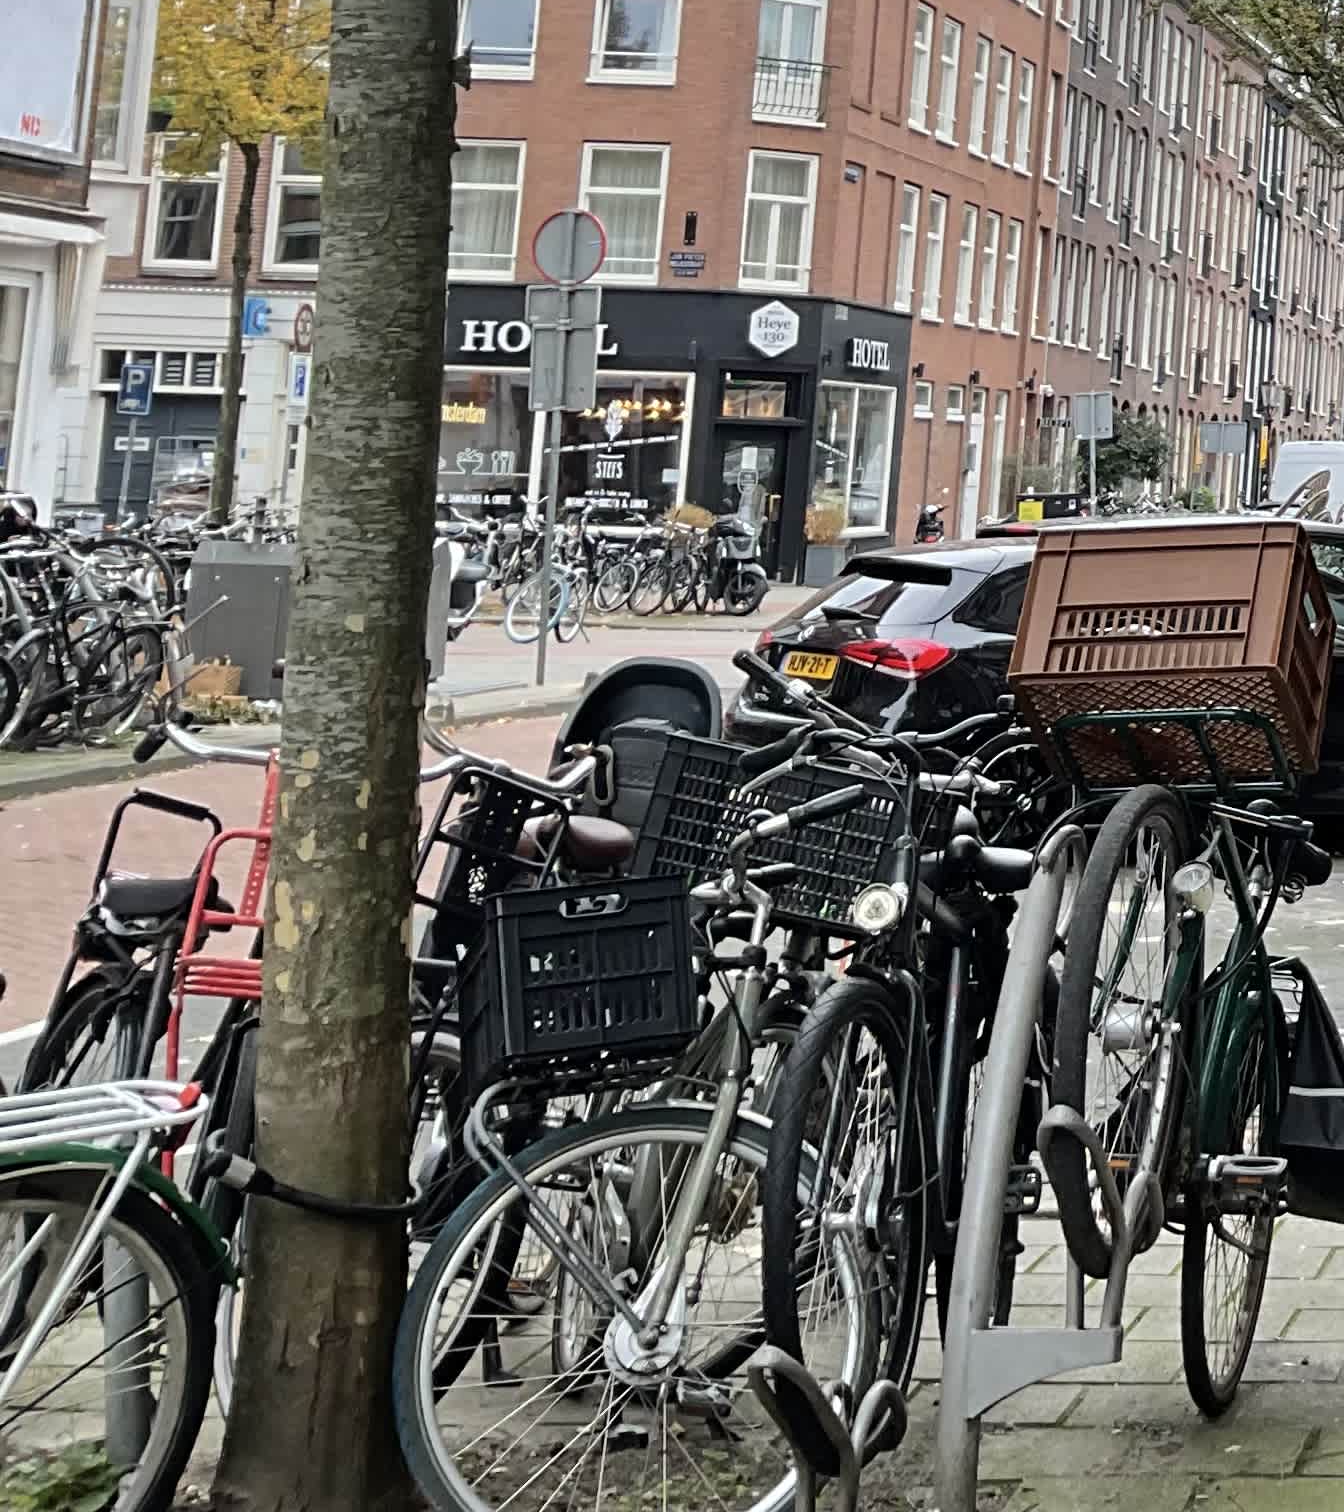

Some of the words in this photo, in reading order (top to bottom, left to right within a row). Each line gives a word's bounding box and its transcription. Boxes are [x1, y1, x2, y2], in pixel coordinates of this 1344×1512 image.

[460, 320, 618, 356] HOL
[758, 316, 792, 332] Heye
[852, 338, 891, 371] HOTEL
[127, 369, 145, 393] P
